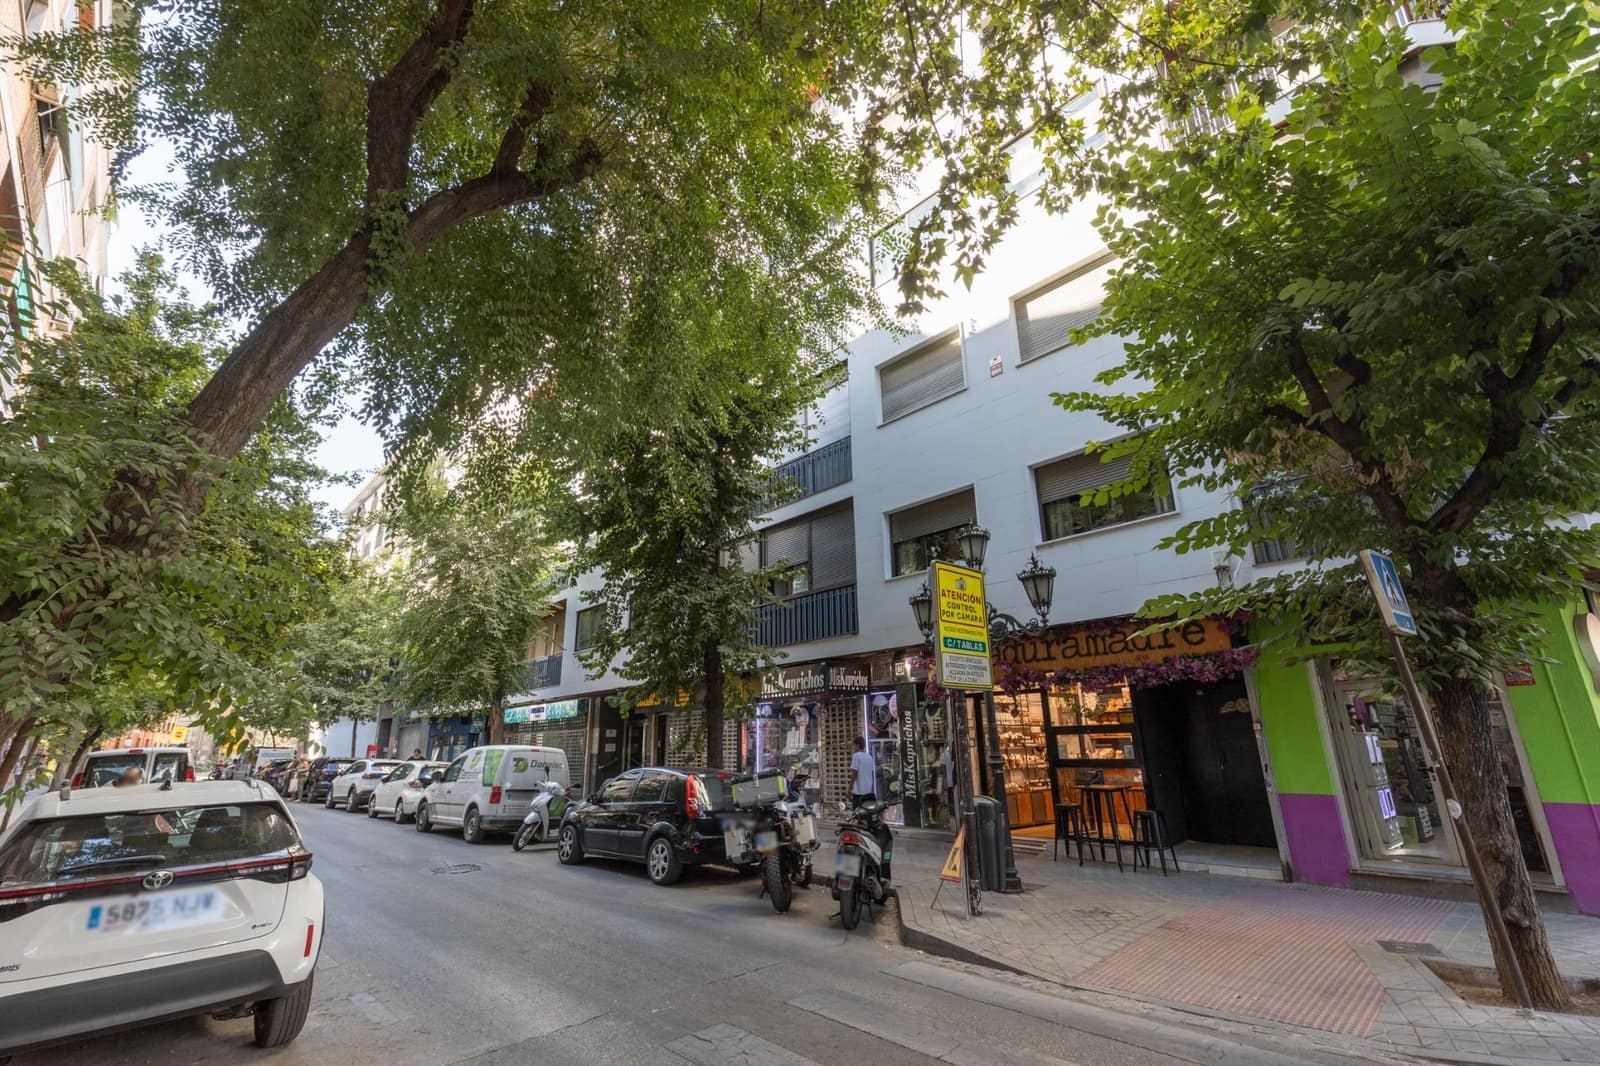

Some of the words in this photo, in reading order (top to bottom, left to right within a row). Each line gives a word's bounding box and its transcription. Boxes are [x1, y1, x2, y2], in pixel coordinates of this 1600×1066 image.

[942, 609, 954, 619] POR
[946, 601, 976, 614] CONTROL
[903, 711, 916, 799] MisKaprichos
